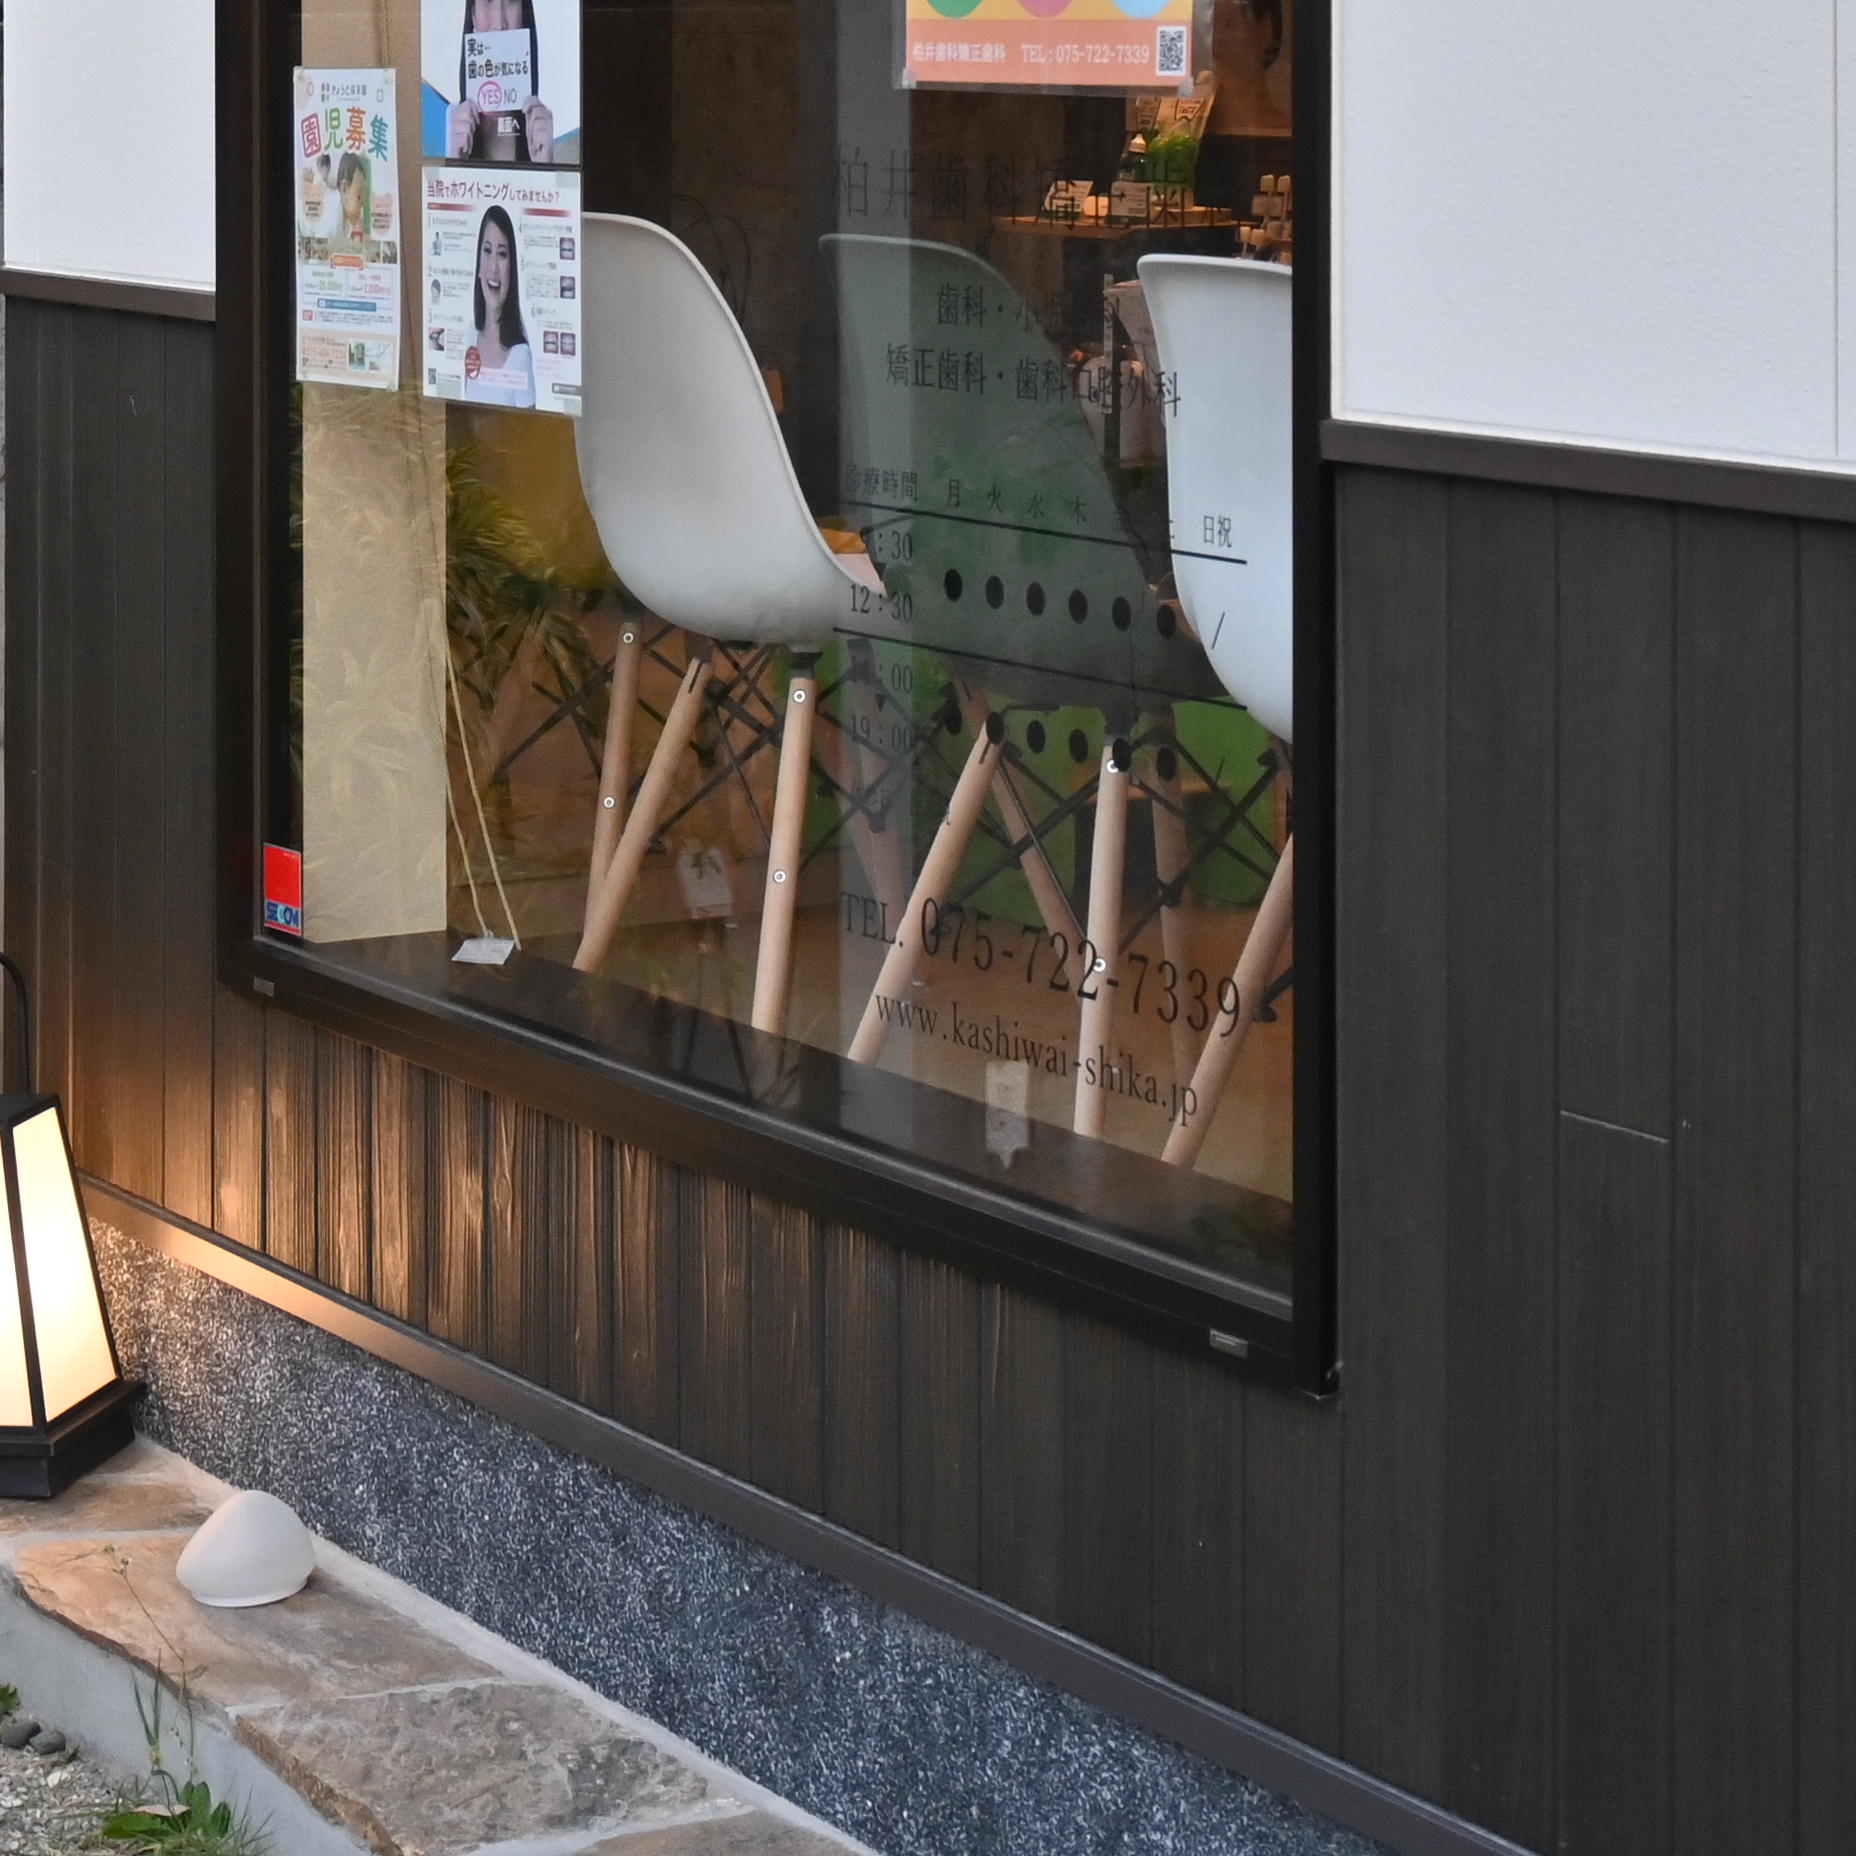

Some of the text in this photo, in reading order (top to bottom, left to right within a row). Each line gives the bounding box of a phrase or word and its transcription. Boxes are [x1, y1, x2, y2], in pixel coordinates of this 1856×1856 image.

[467, 58, 529, 80] 歯の色が気になる
[480, 87, 517, 105] YES NO
[300, 105, 390, 162] 園児募集
[947, 478, 962, 508] 月
[1201, 514, 1234, 550] 日祝
[266, 901, 300, 928] SECOM
[920, 895, 1242, 1039] 075-722-7339
[874, 990, 1199, 1128] www.kashiwai-shika.jp
